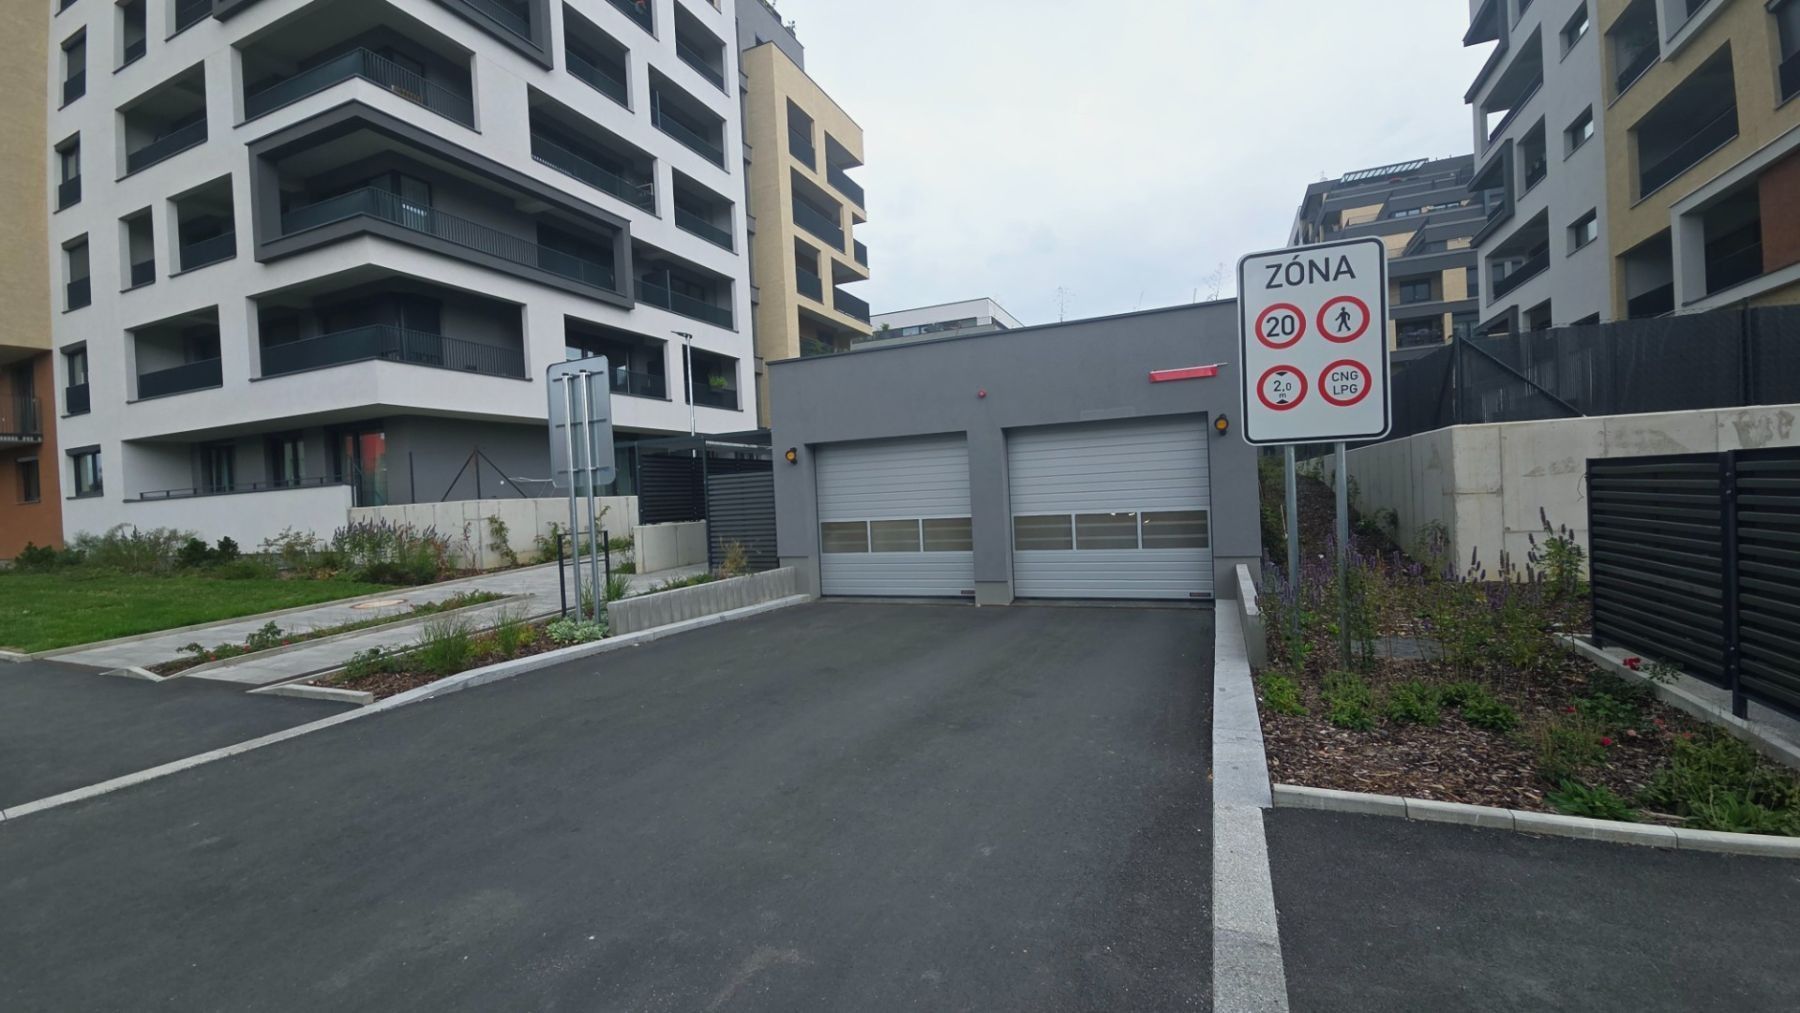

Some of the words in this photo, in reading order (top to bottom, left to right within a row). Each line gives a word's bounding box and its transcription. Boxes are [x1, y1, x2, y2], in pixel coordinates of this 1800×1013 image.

[1265, 254, 1356, 289] ZÓNA
[1266, 315, 1295, 337] 20
[1331, 371, 1358, 382] CNG
[1333, 384, 1358, 396] LPG
